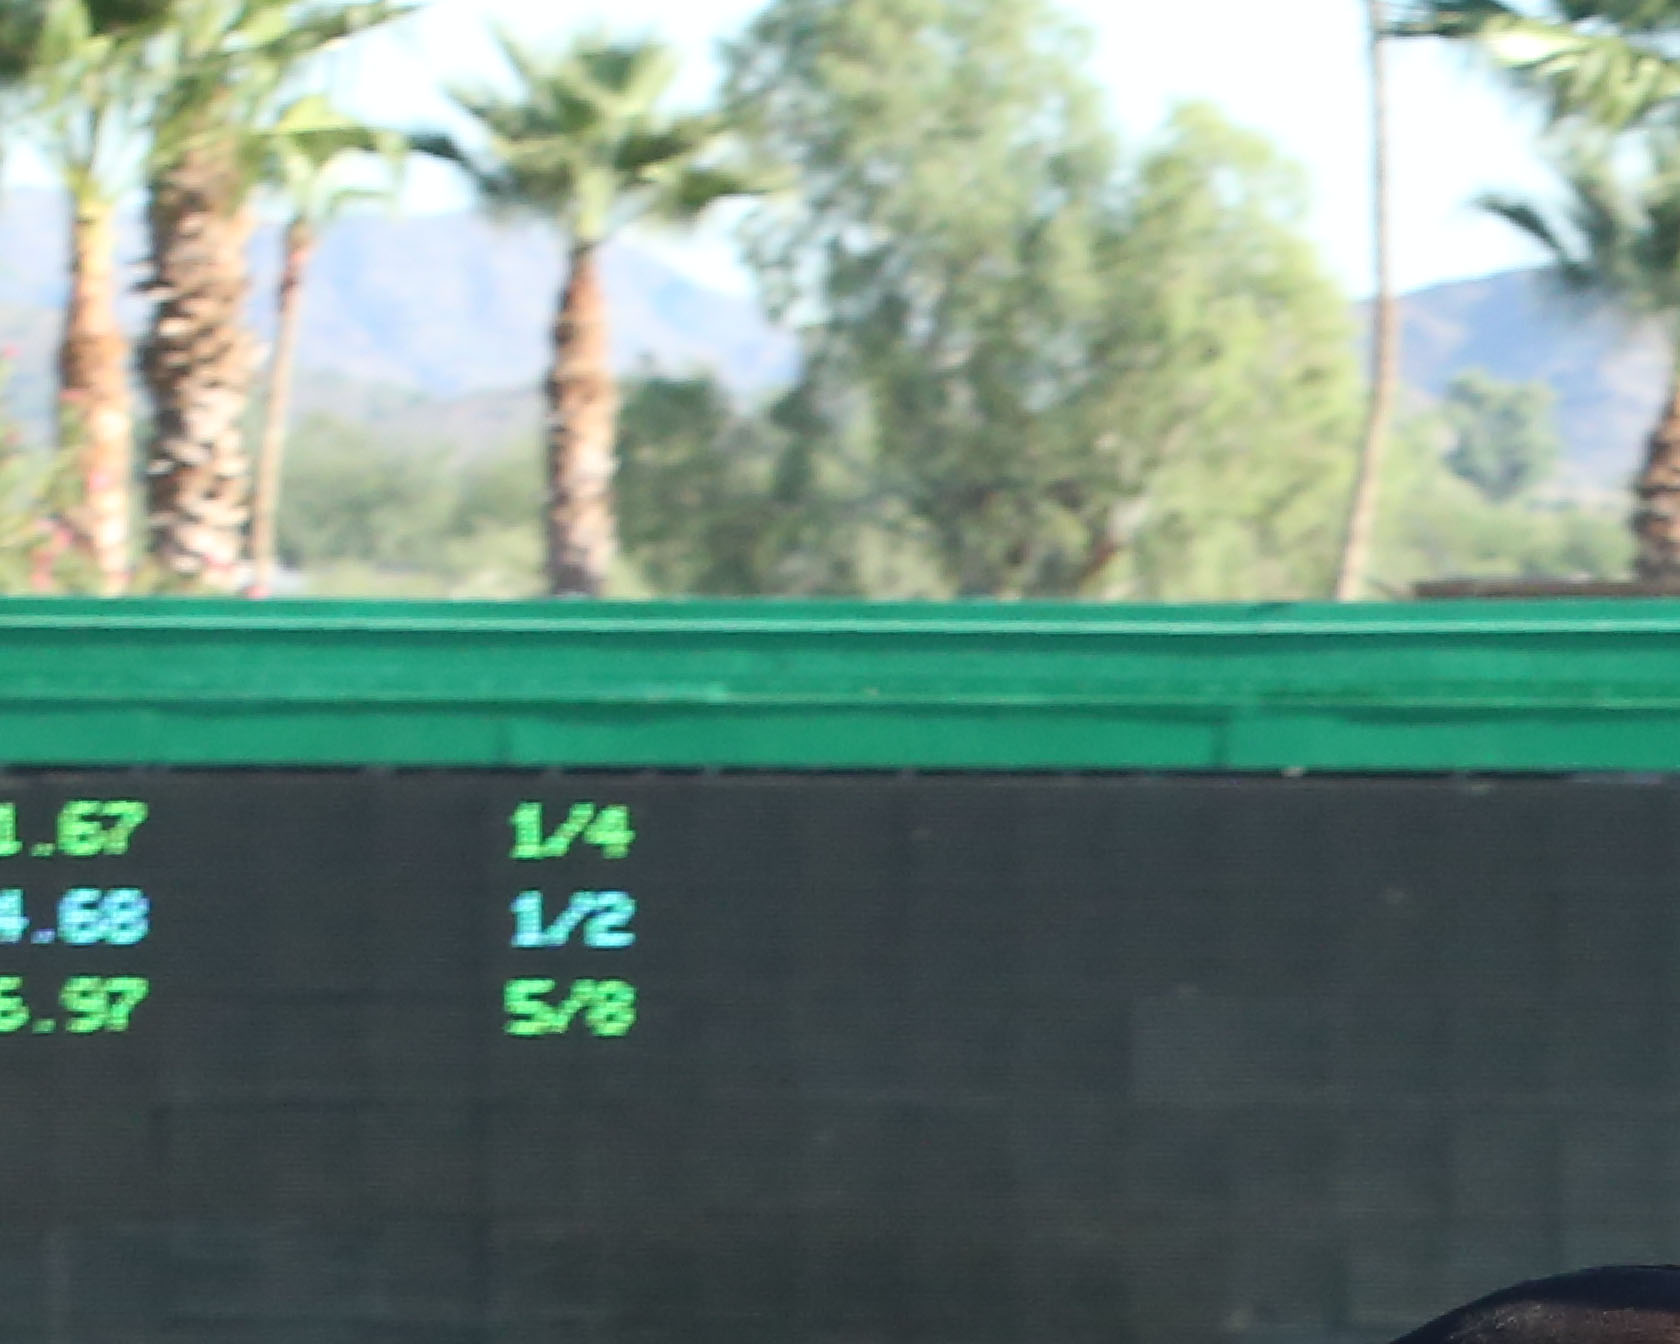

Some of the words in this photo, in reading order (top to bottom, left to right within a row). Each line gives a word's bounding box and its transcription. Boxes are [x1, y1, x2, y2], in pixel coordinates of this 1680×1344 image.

[509, 801, 637, 859] 1/4
[509, 889, 637, 948] 1/2
[503, 978, 638, 1037] 5/8
